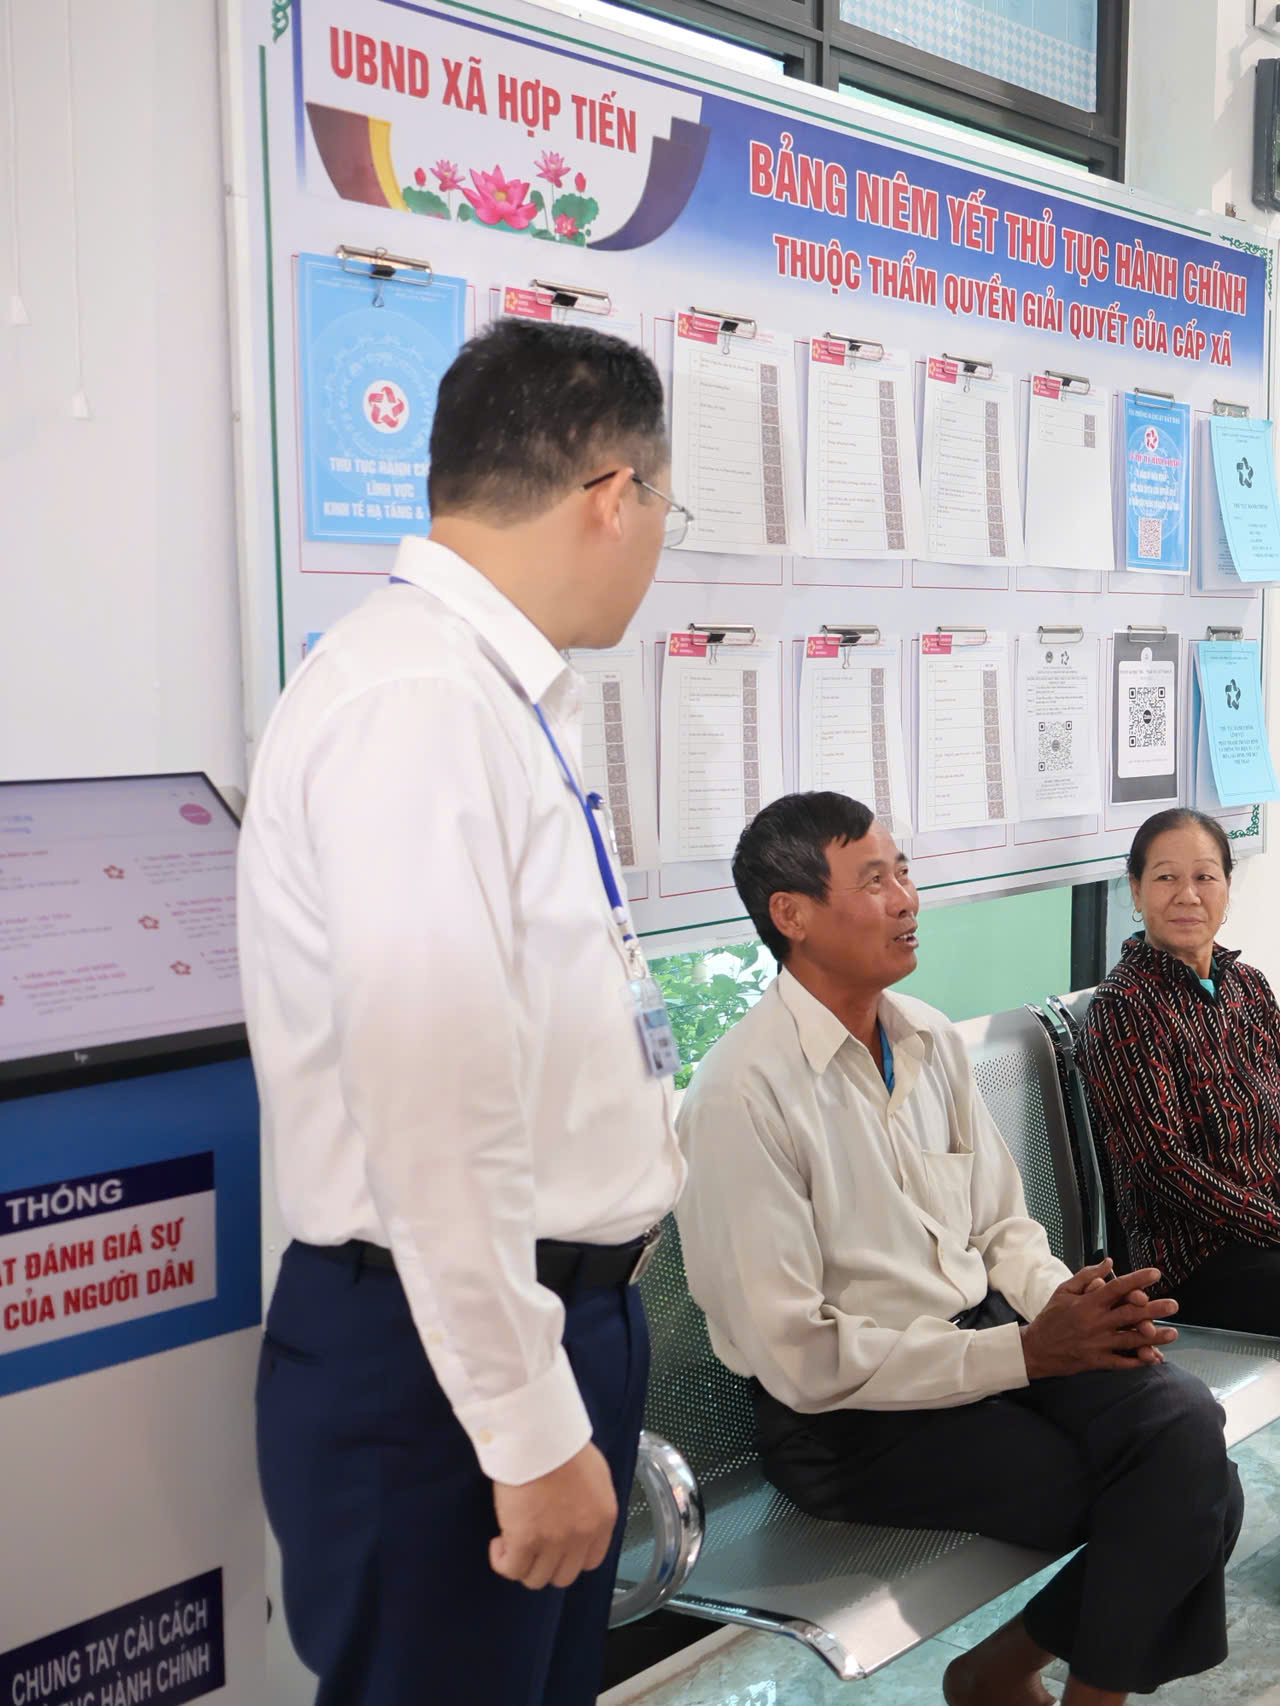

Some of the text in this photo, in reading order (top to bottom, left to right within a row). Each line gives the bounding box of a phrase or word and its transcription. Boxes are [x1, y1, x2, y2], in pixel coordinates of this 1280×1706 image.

[329, 26, 637, 154] UBND XÃ HỢP TIẾN
[750, 132, 1247, 316] BẢNG NIÊM YẾT THỦ TỤC HÀNH CHÍNH
[773, 233, 1232, 367] THUỘC THẨM QUYỀN GIẢI QUYẾT CỦA CẤP XÃ
[4, 1258, 195, 1331] CỦA NGƯỜI DÂN
[25, 1240, 95, 1281] ĐÁNH
[103, 1224, 143, 1262] GIÁ
[151, 1216, 185, 1252] SỰ
[12, 1649, 81, 1706] CHUNG
[85, 1633, 119, 1676] TAY
[158, 1598, 208, 1646] CÁCH
[156, 1642, 210, 1693] CHÍNH
